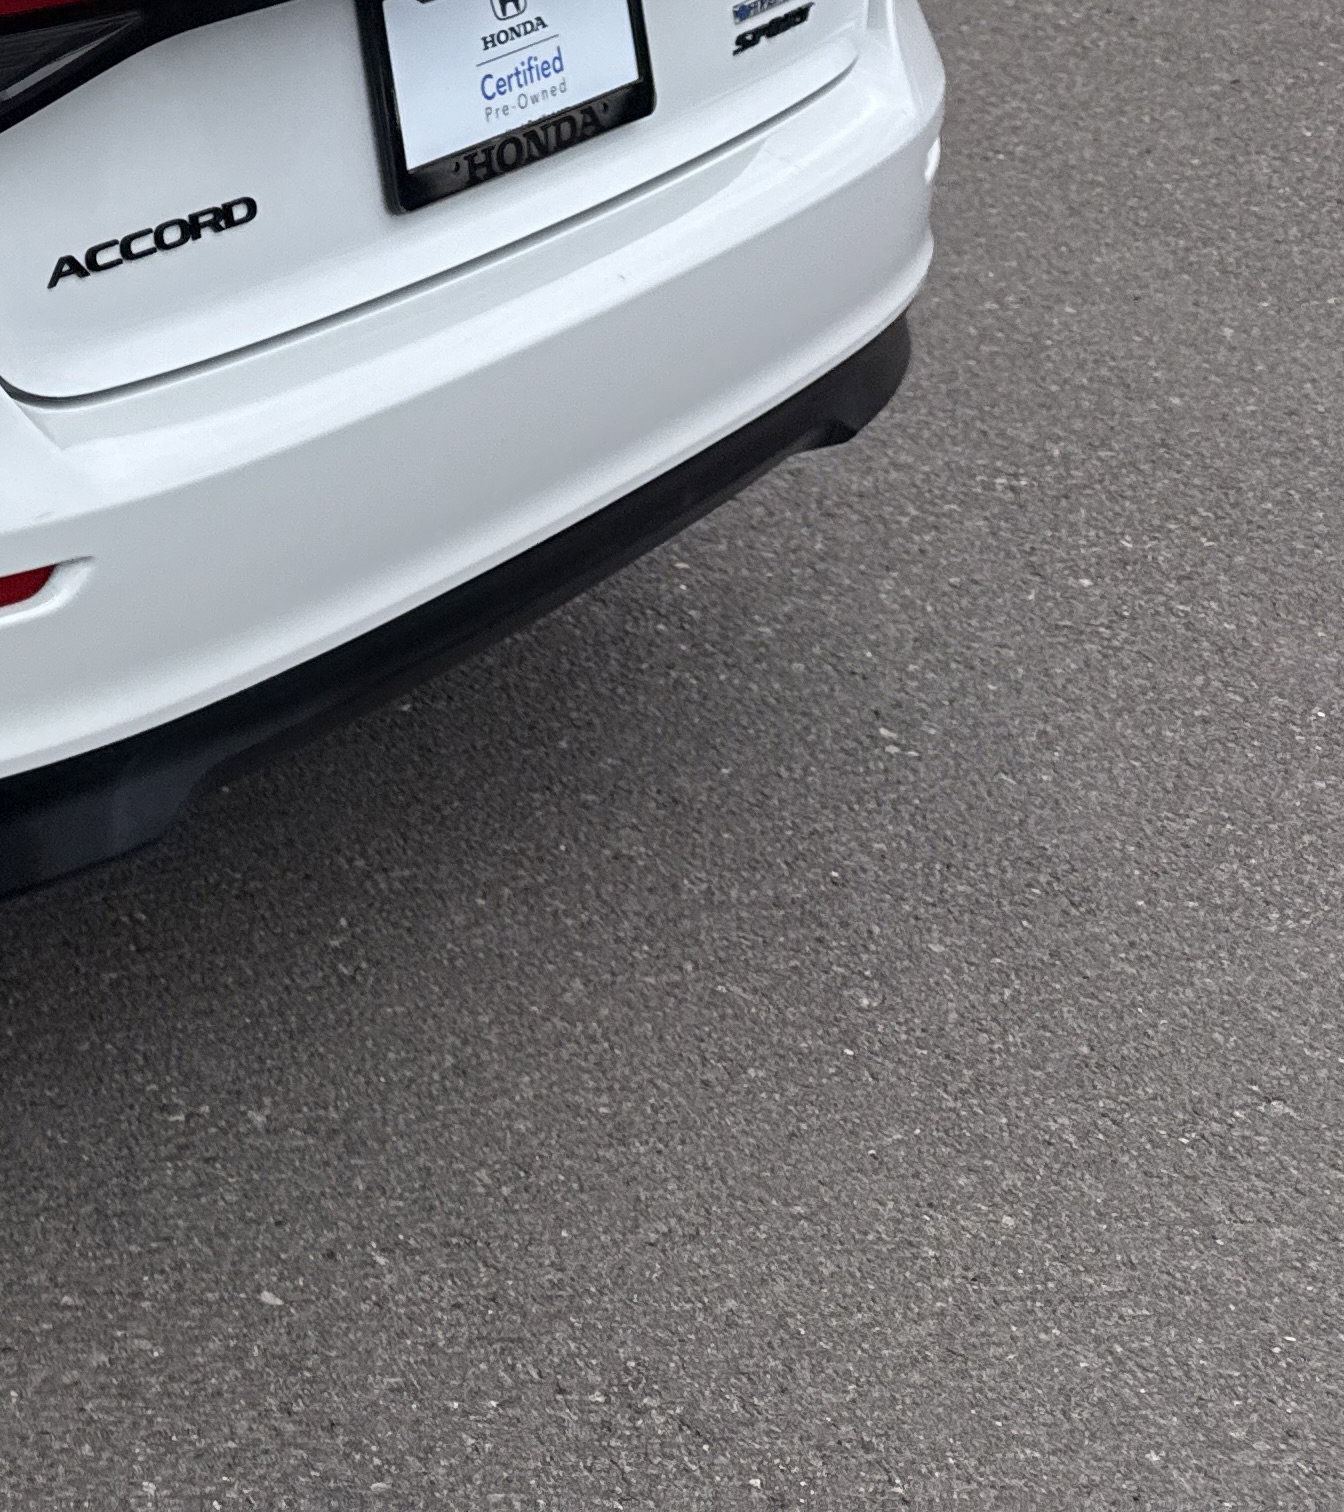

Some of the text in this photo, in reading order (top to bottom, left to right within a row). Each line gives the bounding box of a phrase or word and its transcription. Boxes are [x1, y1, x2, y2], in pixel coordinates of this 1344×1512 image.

[481, 16, 548, 51] HONDA
[732, 1, 815, 56] SPORT
[480, 46, 564, 101] Certified
[485, 78, 568, 122] Pre-Owned
[462, 101, 604, 185] HONDA
[47, 195, 258, 289] ACCORD
